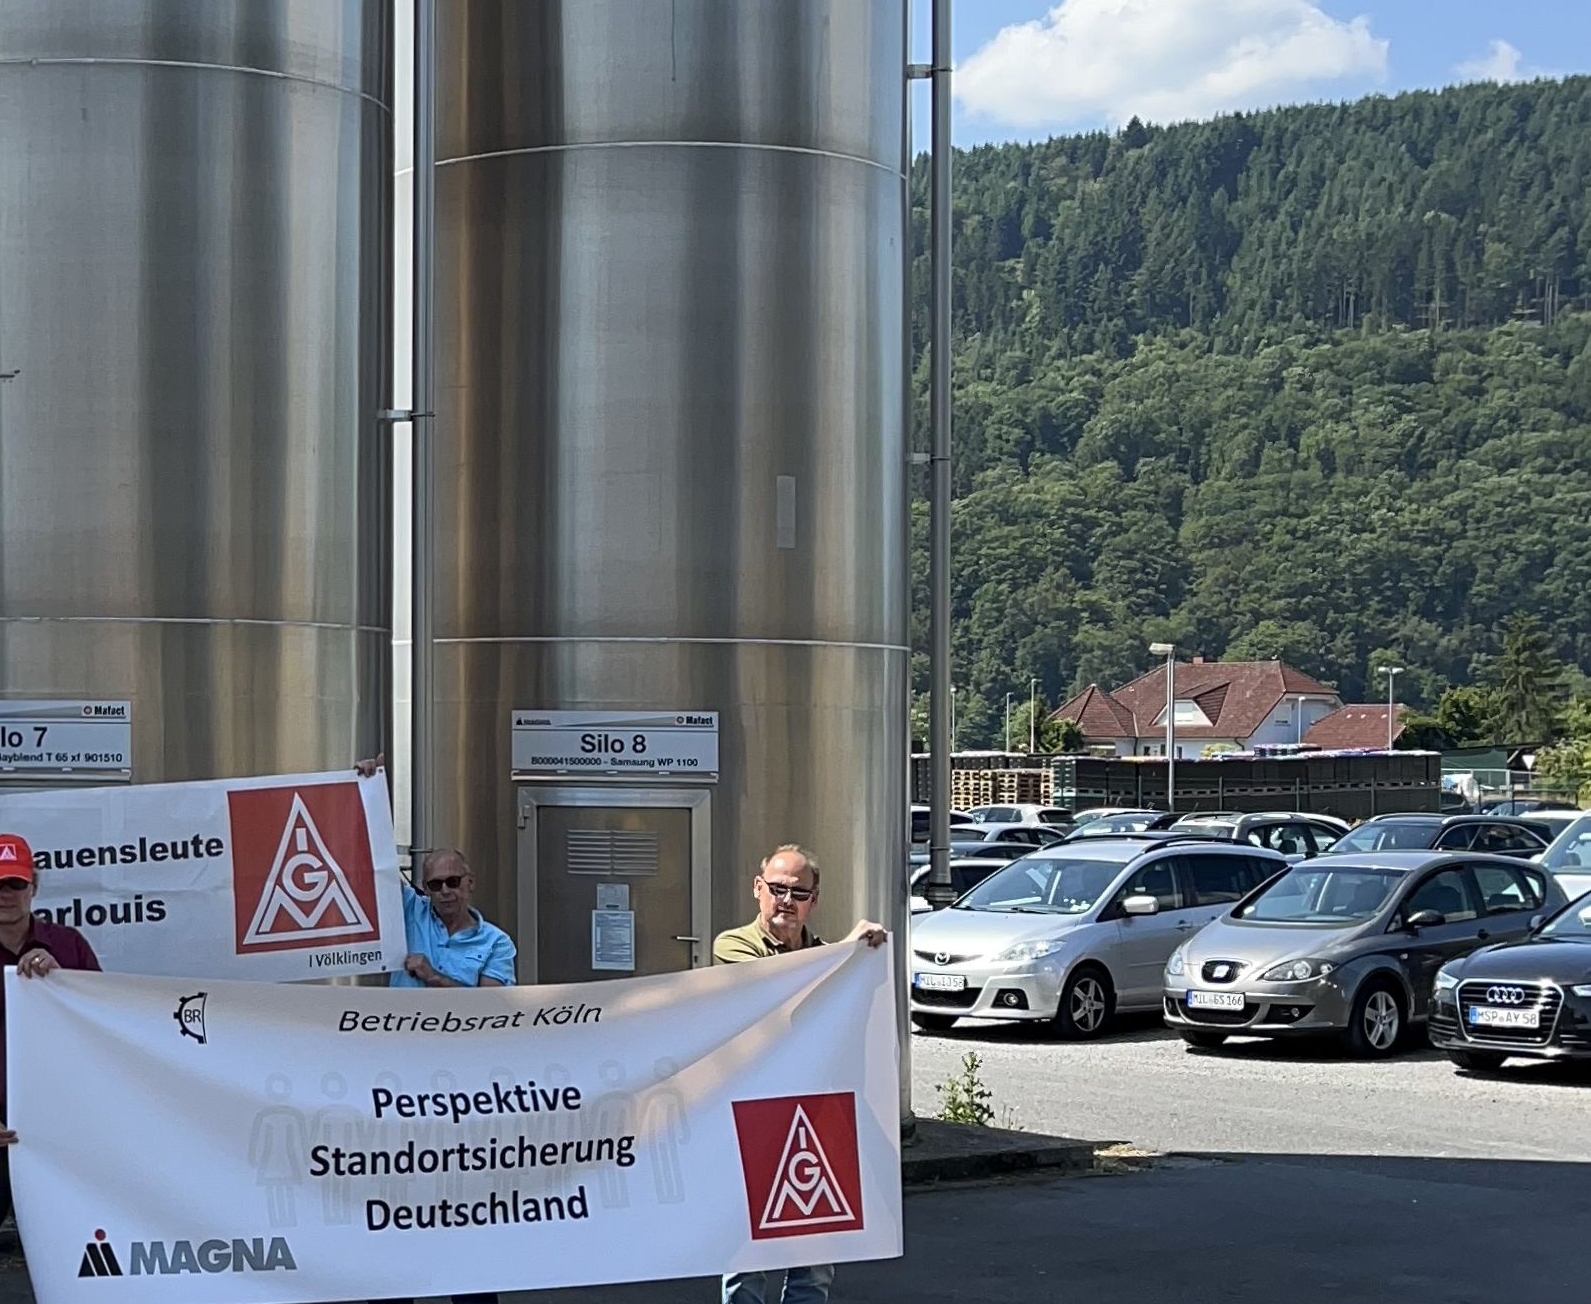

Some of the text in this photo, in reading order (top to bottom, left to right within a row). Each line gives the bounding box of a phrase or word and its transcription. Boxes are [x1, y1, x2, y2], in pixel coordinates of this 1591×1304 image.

[94, 705, 125, 716] Mafact
[685, 715, 713, 725] Mafact
[33, 726, 48, 747] 7
[580, 733, 647, 754] Silo 8
[46, 752, 52, 762] T
[70, 752, 81, 762] xf
[84, 753, 123, 763] 901510
[610, 757, 655, 768] Samsung
[658, 758, 674, 767] WP
[676, 758, 699, 767] 1100
[315, 949, 383, 969] Völklingen
[1226, 995, 1243, 1007] 166
[338, 1006, 525, 1035] Betriebsrat
[531, 1002, 602, 1027] Köln
[1505, 1011, 1520, 1023] AY
[1523, 1013, 1537, 1025] 58
[372, 1080, 583, 1124] Perspektive
[309, 1131, 637, 1179] Standortsicherung
[365, 1185, 590, 1232] Deutschland
[128, 1235, 296, 1277] MAGNA
